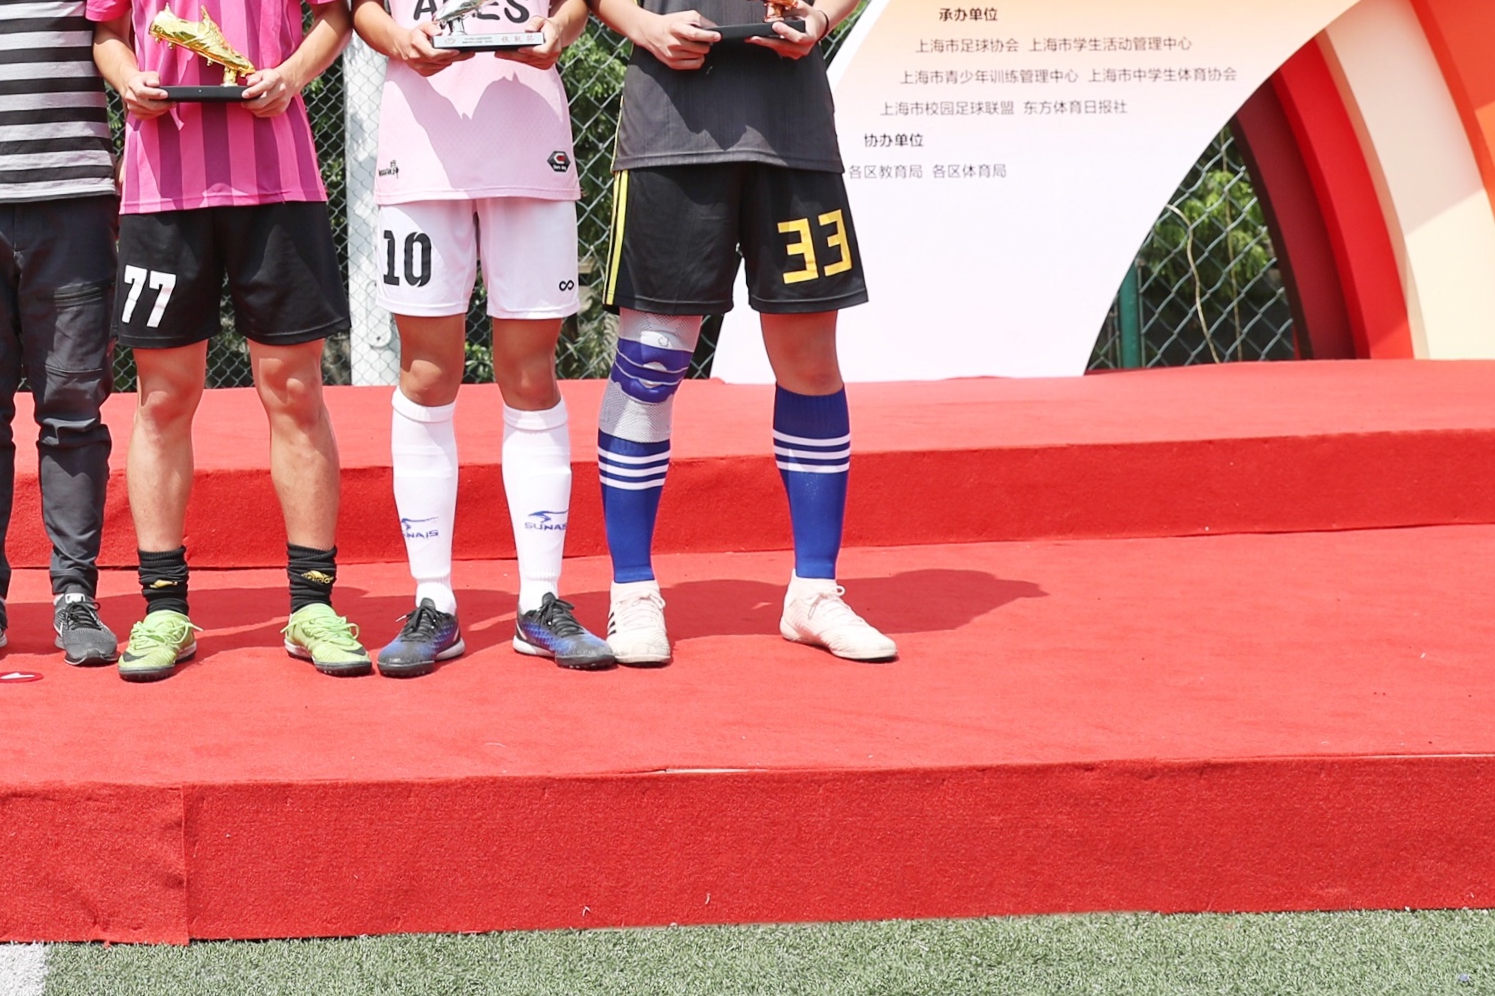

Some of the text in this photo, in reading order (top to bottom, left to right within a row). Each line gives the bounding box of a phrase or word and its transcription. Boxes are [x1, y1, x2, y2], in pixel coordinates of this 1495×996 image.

[939, 7, 998, 21] 承办单位
[915, 36, 1192, 53] 上海市足球协会 上海市学生活动管理中心
[900, 67, 1237, 84] 上海市青少年训练管理中心 上海市中学生体育协会
[880, 100, 1128, 116] 上海市校园足球联盟 东方体育日报社
[864, 133, 924, 147] 协办单位
[848, 163, 1007, 179] 各区教育局 各区体育局
[777, 209, 852, 284] 33
[383, 230, 432, 287] 10
[121, 264, 177, 328] 77
